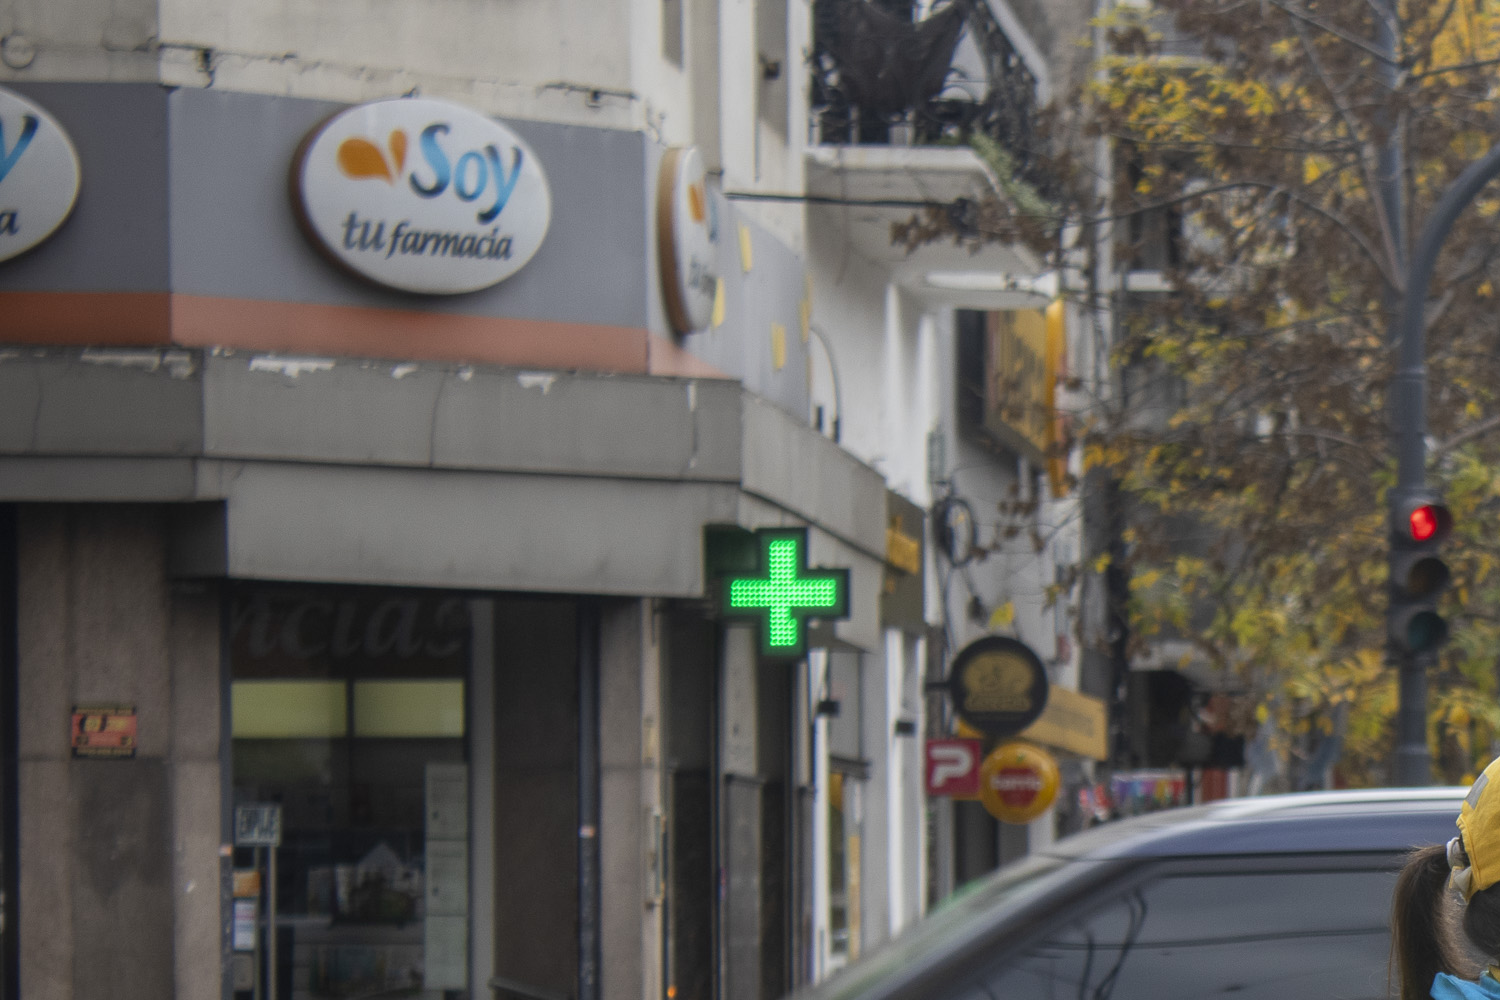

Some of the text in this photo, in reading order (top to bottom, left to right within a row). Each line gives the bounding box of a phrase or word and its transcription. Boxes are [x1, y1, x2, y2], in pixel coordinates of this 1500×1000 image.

[409, 123, 522, 225] Soy
[343, 212, 512, 260] tu farmacia
